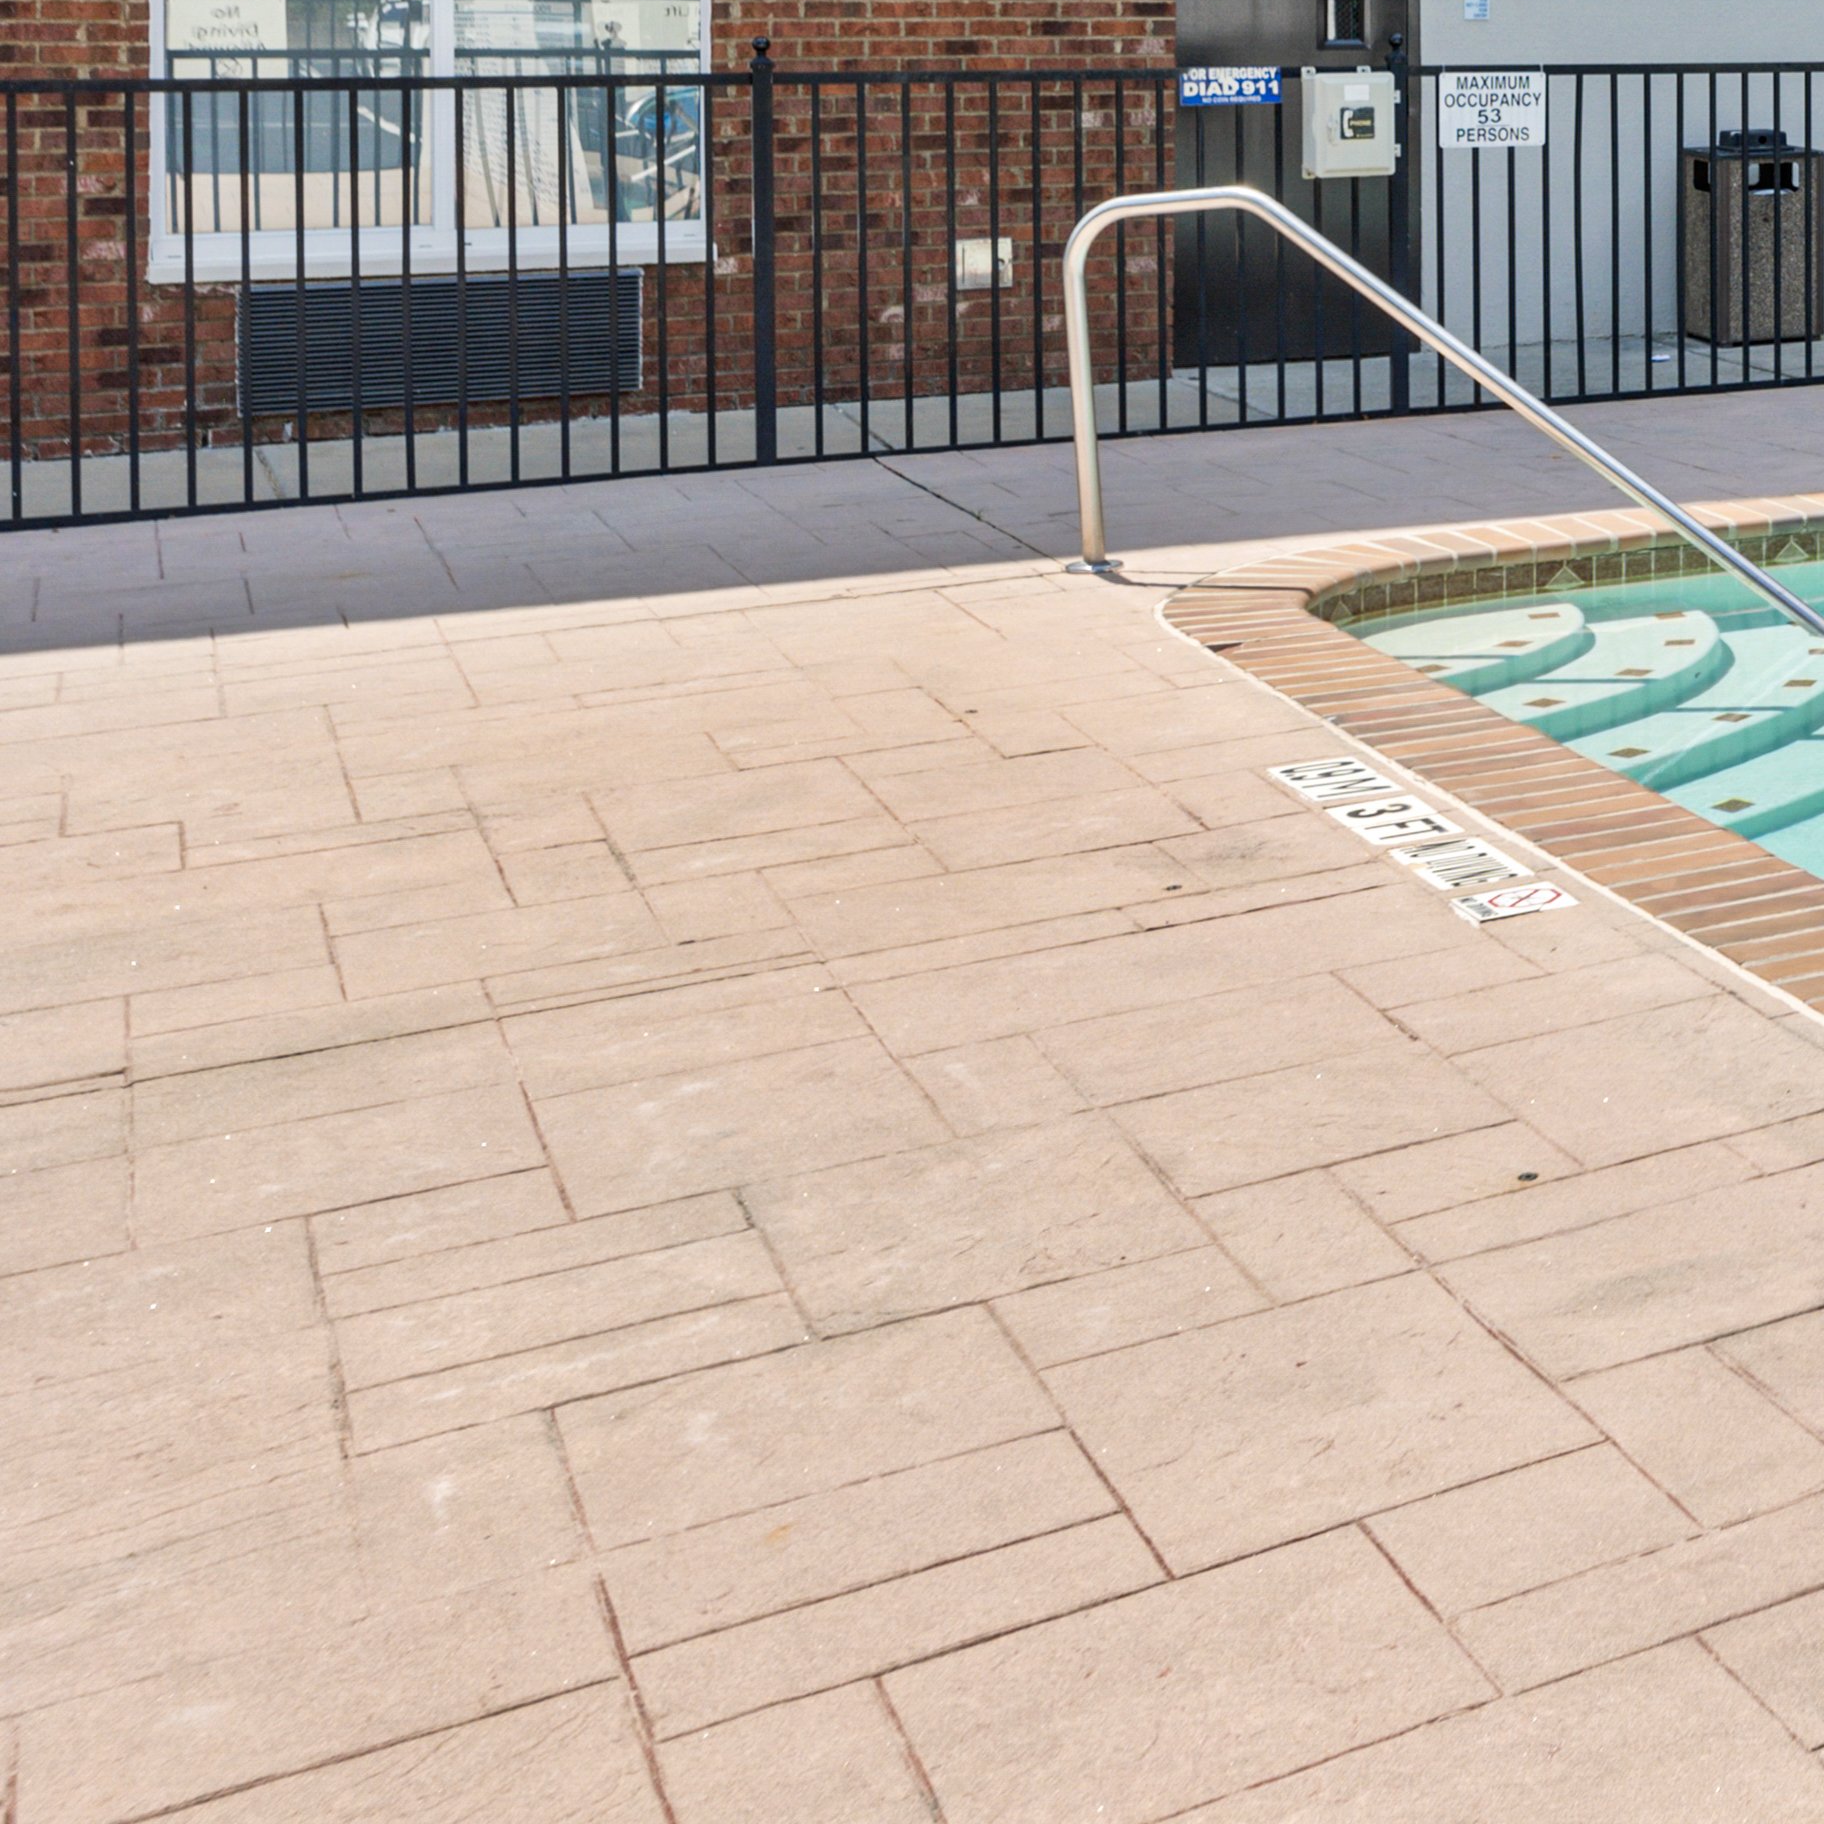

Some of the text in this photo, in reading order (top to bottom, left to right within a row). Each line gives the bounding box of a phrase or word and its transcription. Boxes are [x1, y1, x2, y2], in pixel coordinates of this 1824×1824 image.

[1208, 67, 1277, 80] EMERGENCY
[1241, 80, 1279, 95] 911
[1456, 75, 1530, 90] MAXIMUM
[1444, 92, 1542, 108] OCCUPANCY
[1477, 108, 1502, 125] 53
[1456, 126, 1530, 143] PERSONS
[1346, 802, 1450, 841] 3 FT
